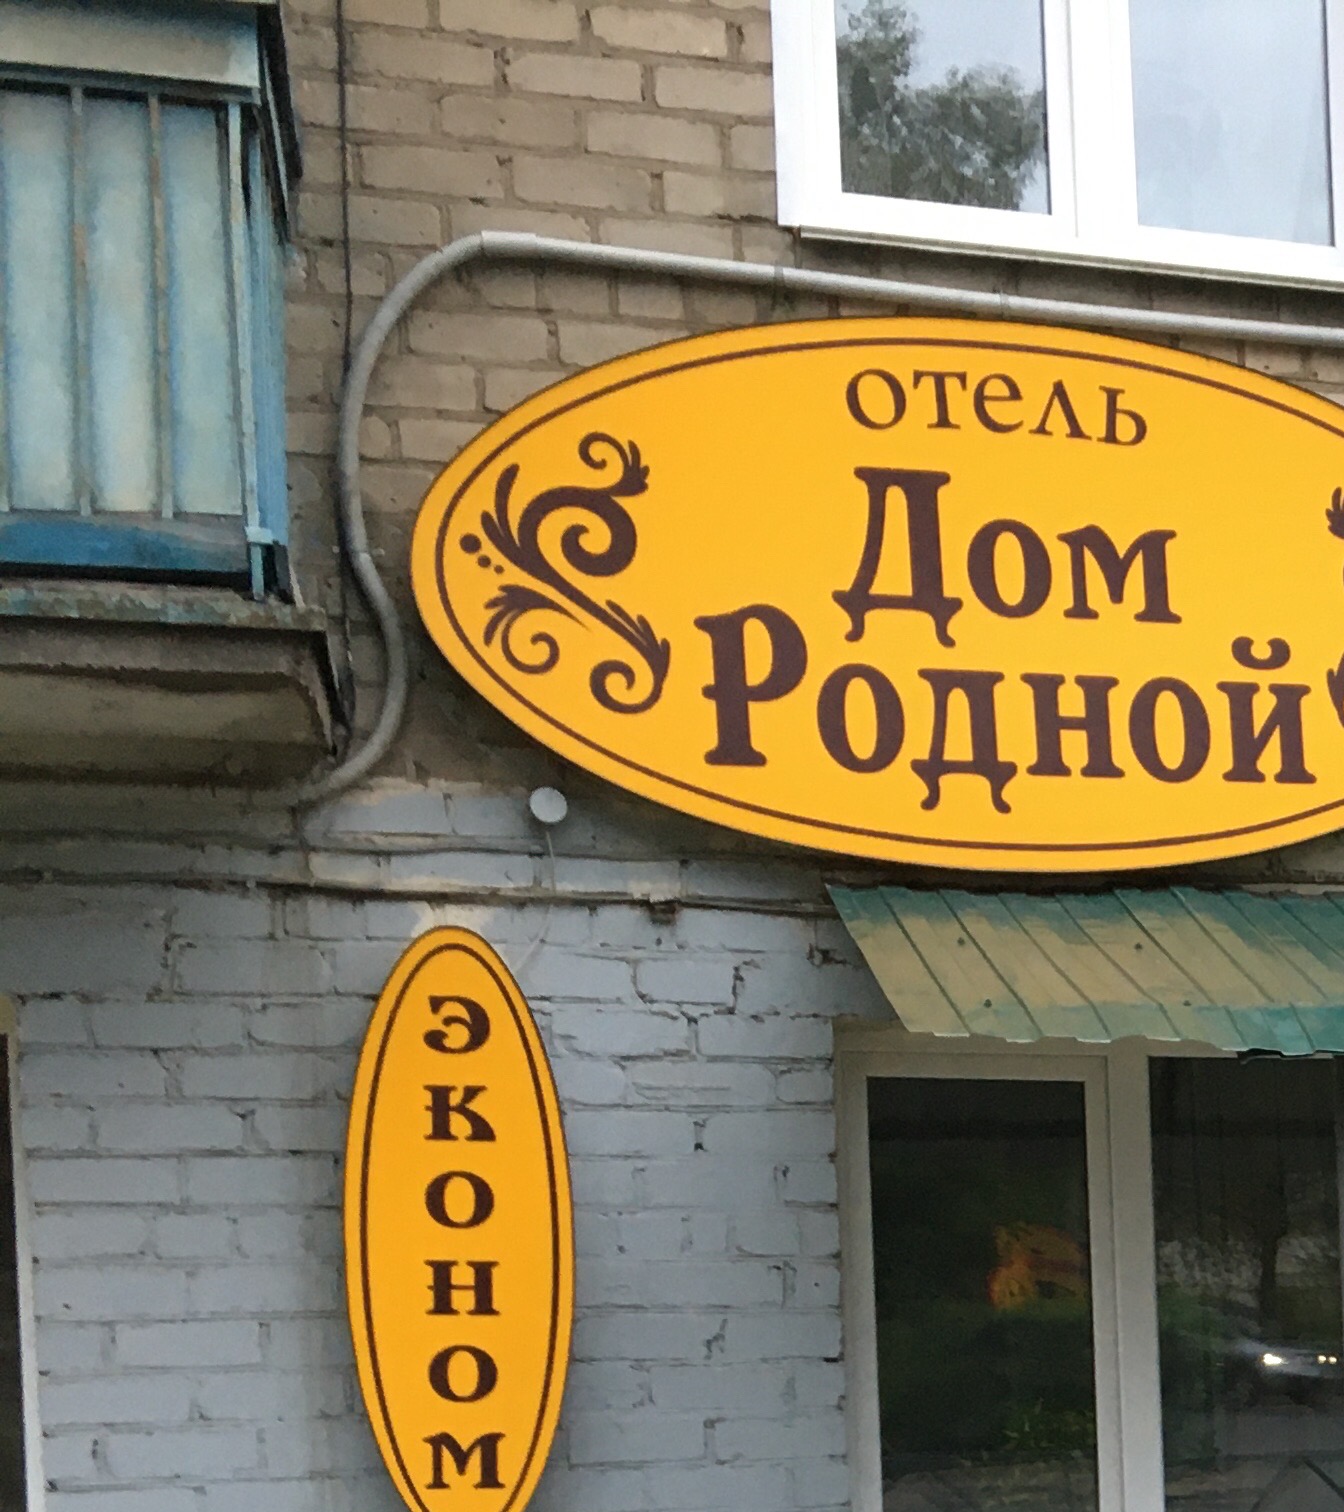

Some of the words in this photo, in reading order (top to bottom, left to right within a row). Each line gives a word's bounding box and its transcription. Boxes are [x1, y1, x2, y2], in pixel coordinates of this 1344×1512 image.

[846, 367, 1148, 446] отель
[832, 466, 1182, 648] Дом
[693, 603, 1317, 815] Родной
[422, 994, 507, 1491] ЭКОНОМ
